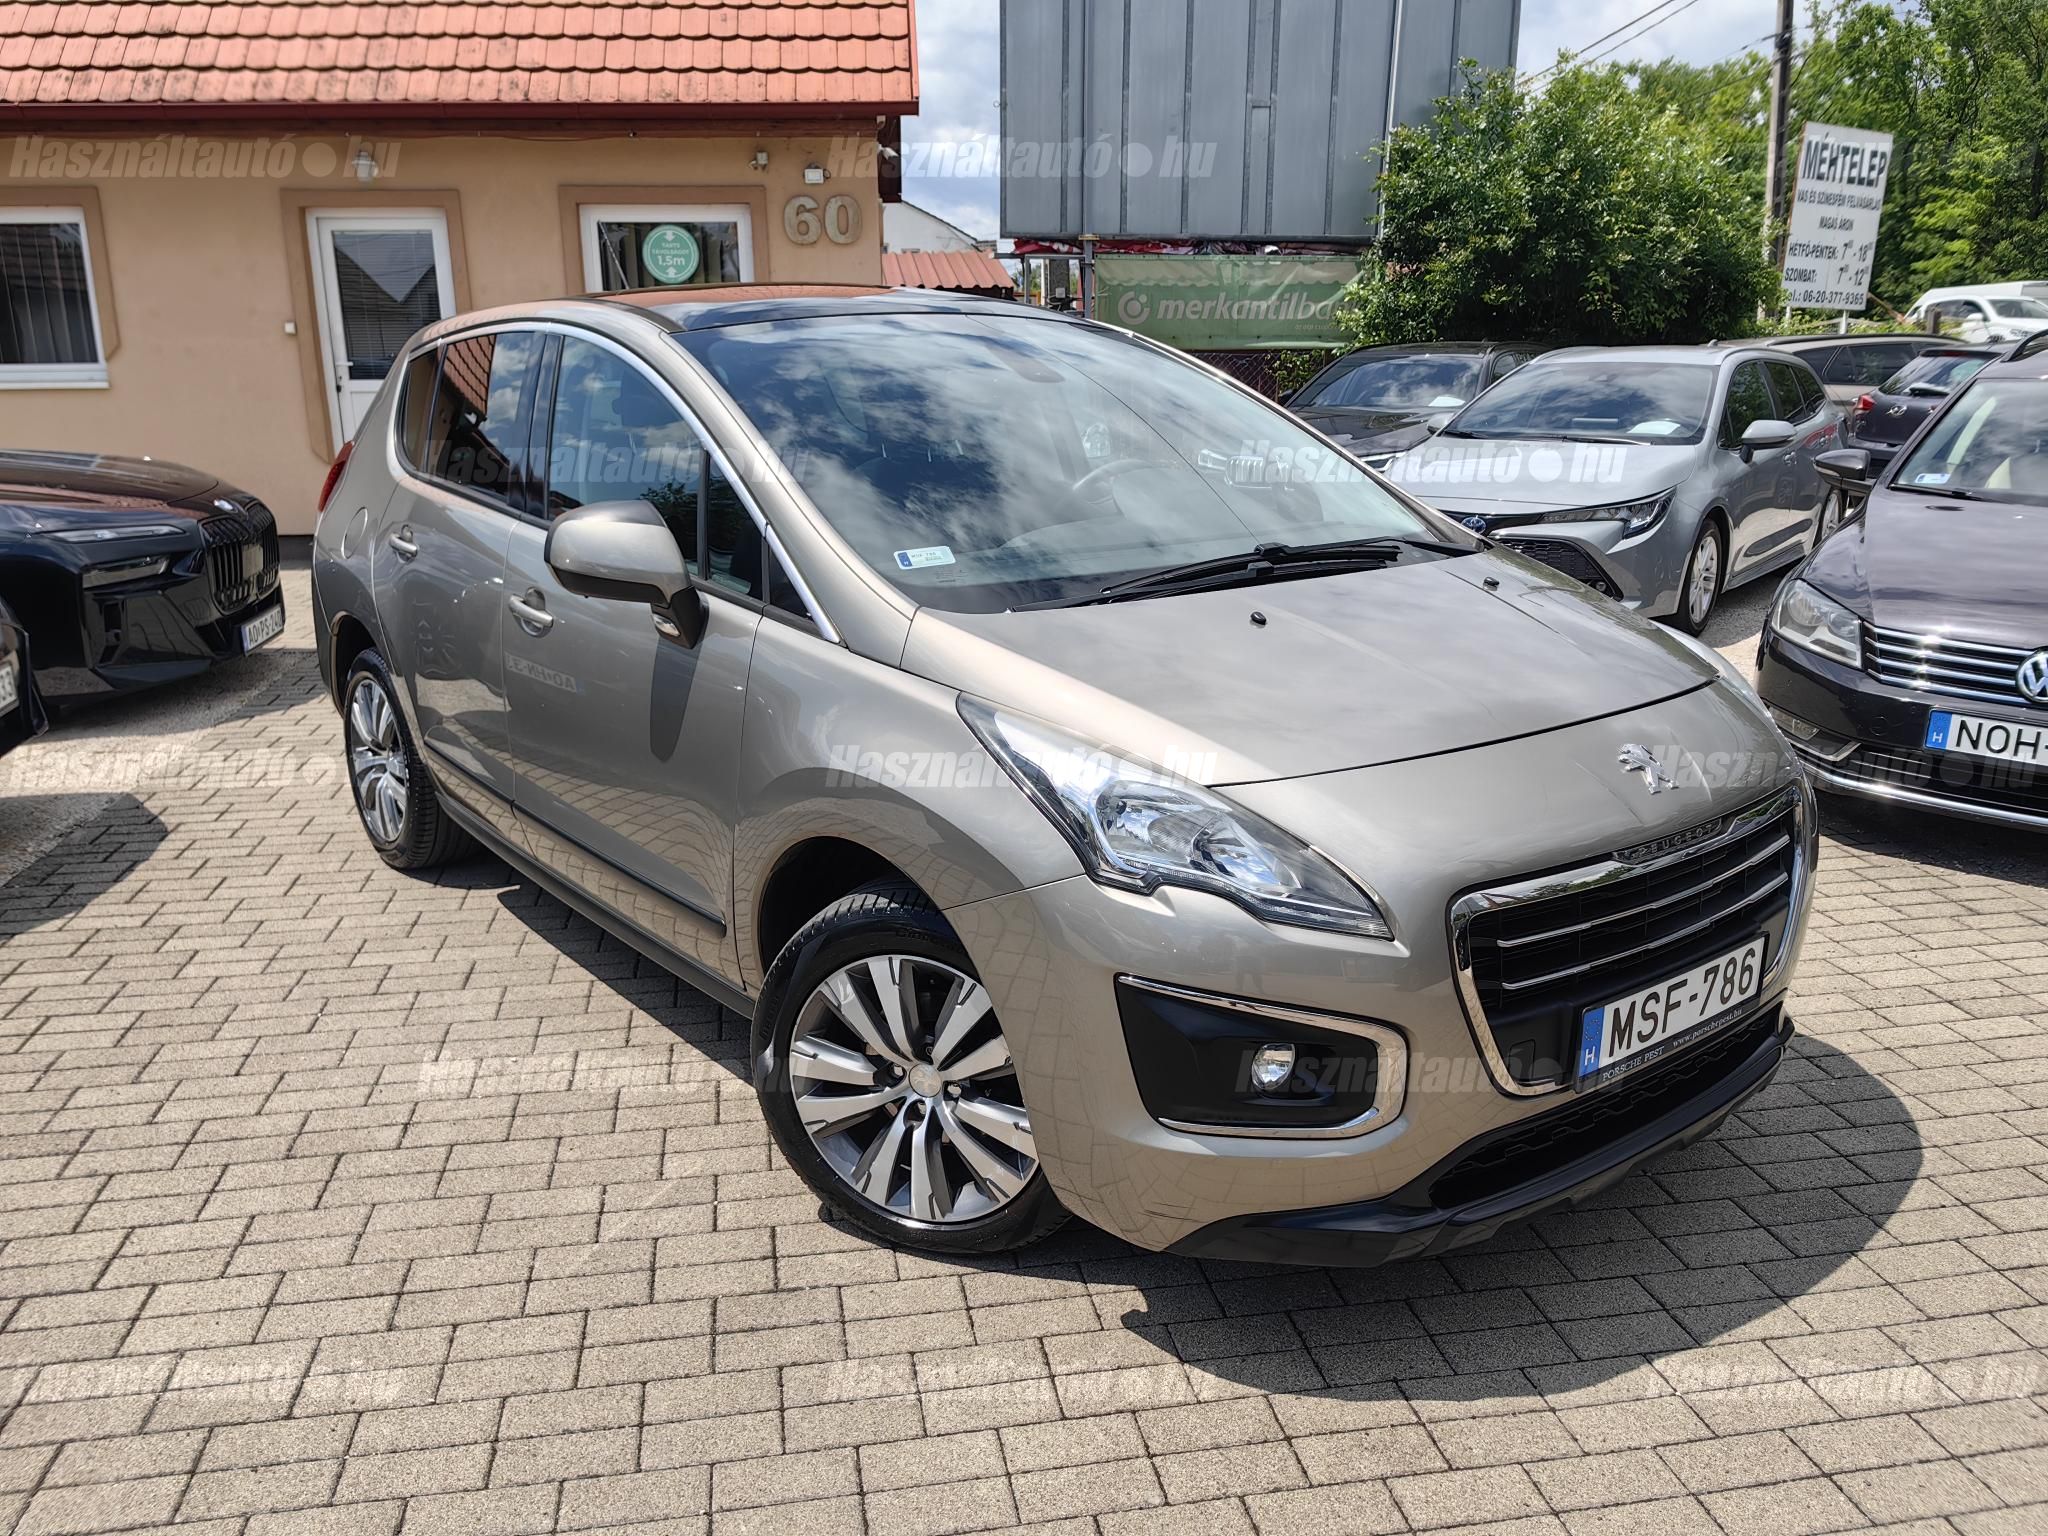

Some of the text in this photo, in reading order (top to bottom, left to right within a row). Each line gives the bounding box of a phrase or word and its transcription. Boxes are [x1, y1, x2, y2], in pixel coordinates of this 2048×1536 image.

[1802, 132, 1888, 188] MÉHTELEP
[783, 193, 863, 246] 60
[1157, 291, 1358, 321] merkantilba
[1933, 732, 1943, 743] H
[1638, 824, 1713, 855] PEUGEOT
[1608, 947, 1756, 1058] MSF-786
[1672, 1007, 1743, 1048] www.porschepest.hu
[1584, 1046, 1596, 1066] H
[1602, 1055, 1642, 1081] PORSCHE
[1643, 1045, 1665, 1063] PEST
